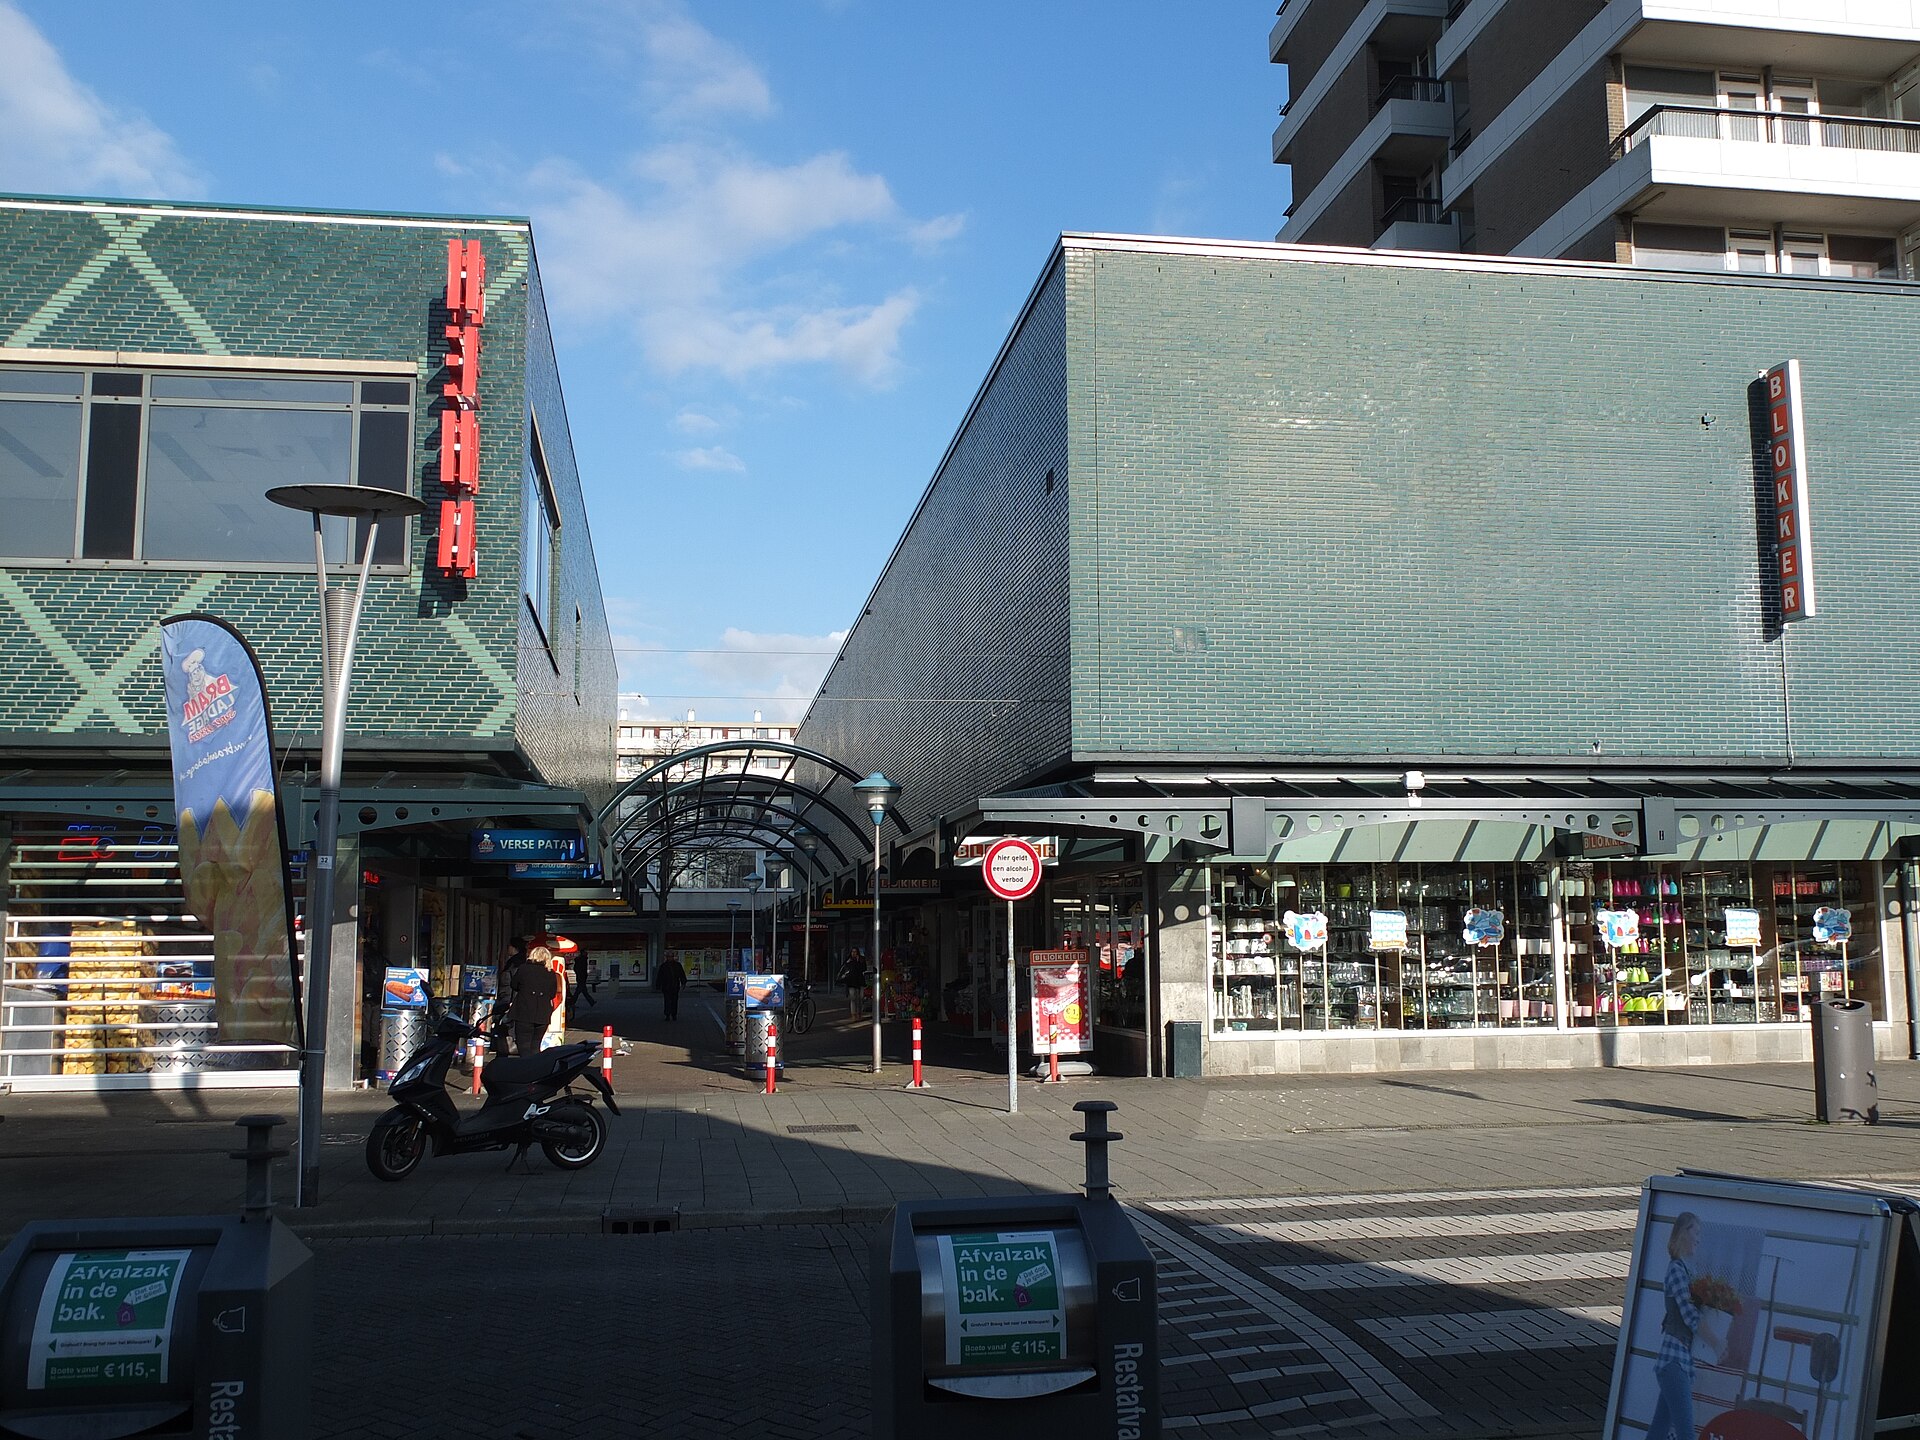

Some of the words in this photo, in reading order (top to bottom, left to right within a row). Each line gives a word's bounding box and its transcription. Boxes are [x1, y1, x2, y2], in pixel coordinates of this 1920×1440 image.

[1770, 376, 1796, 612] BLOKKER
[500, 839, 534, 850] VERSE
[537, 839, 575, 850] PATAT
[958, 1246, 1048, 1264] Afvalzak
[67, 1264, 171, 1281] Afvalzak
[960, 1266, 978, 1282] in
[983, 1265, 1008, 1282] de
[63, 1283, 83, 1299] in
[89, 1282, 118, 1298] de
[962, 1285, 1005, 1303] bak.
[58, 1303, 105, 1322] bak.
[964, 1344, 986, 1352] Boete
[50, 1365, 75, 1374] Boete
[76, 1364, 99, 1373] vanaf
